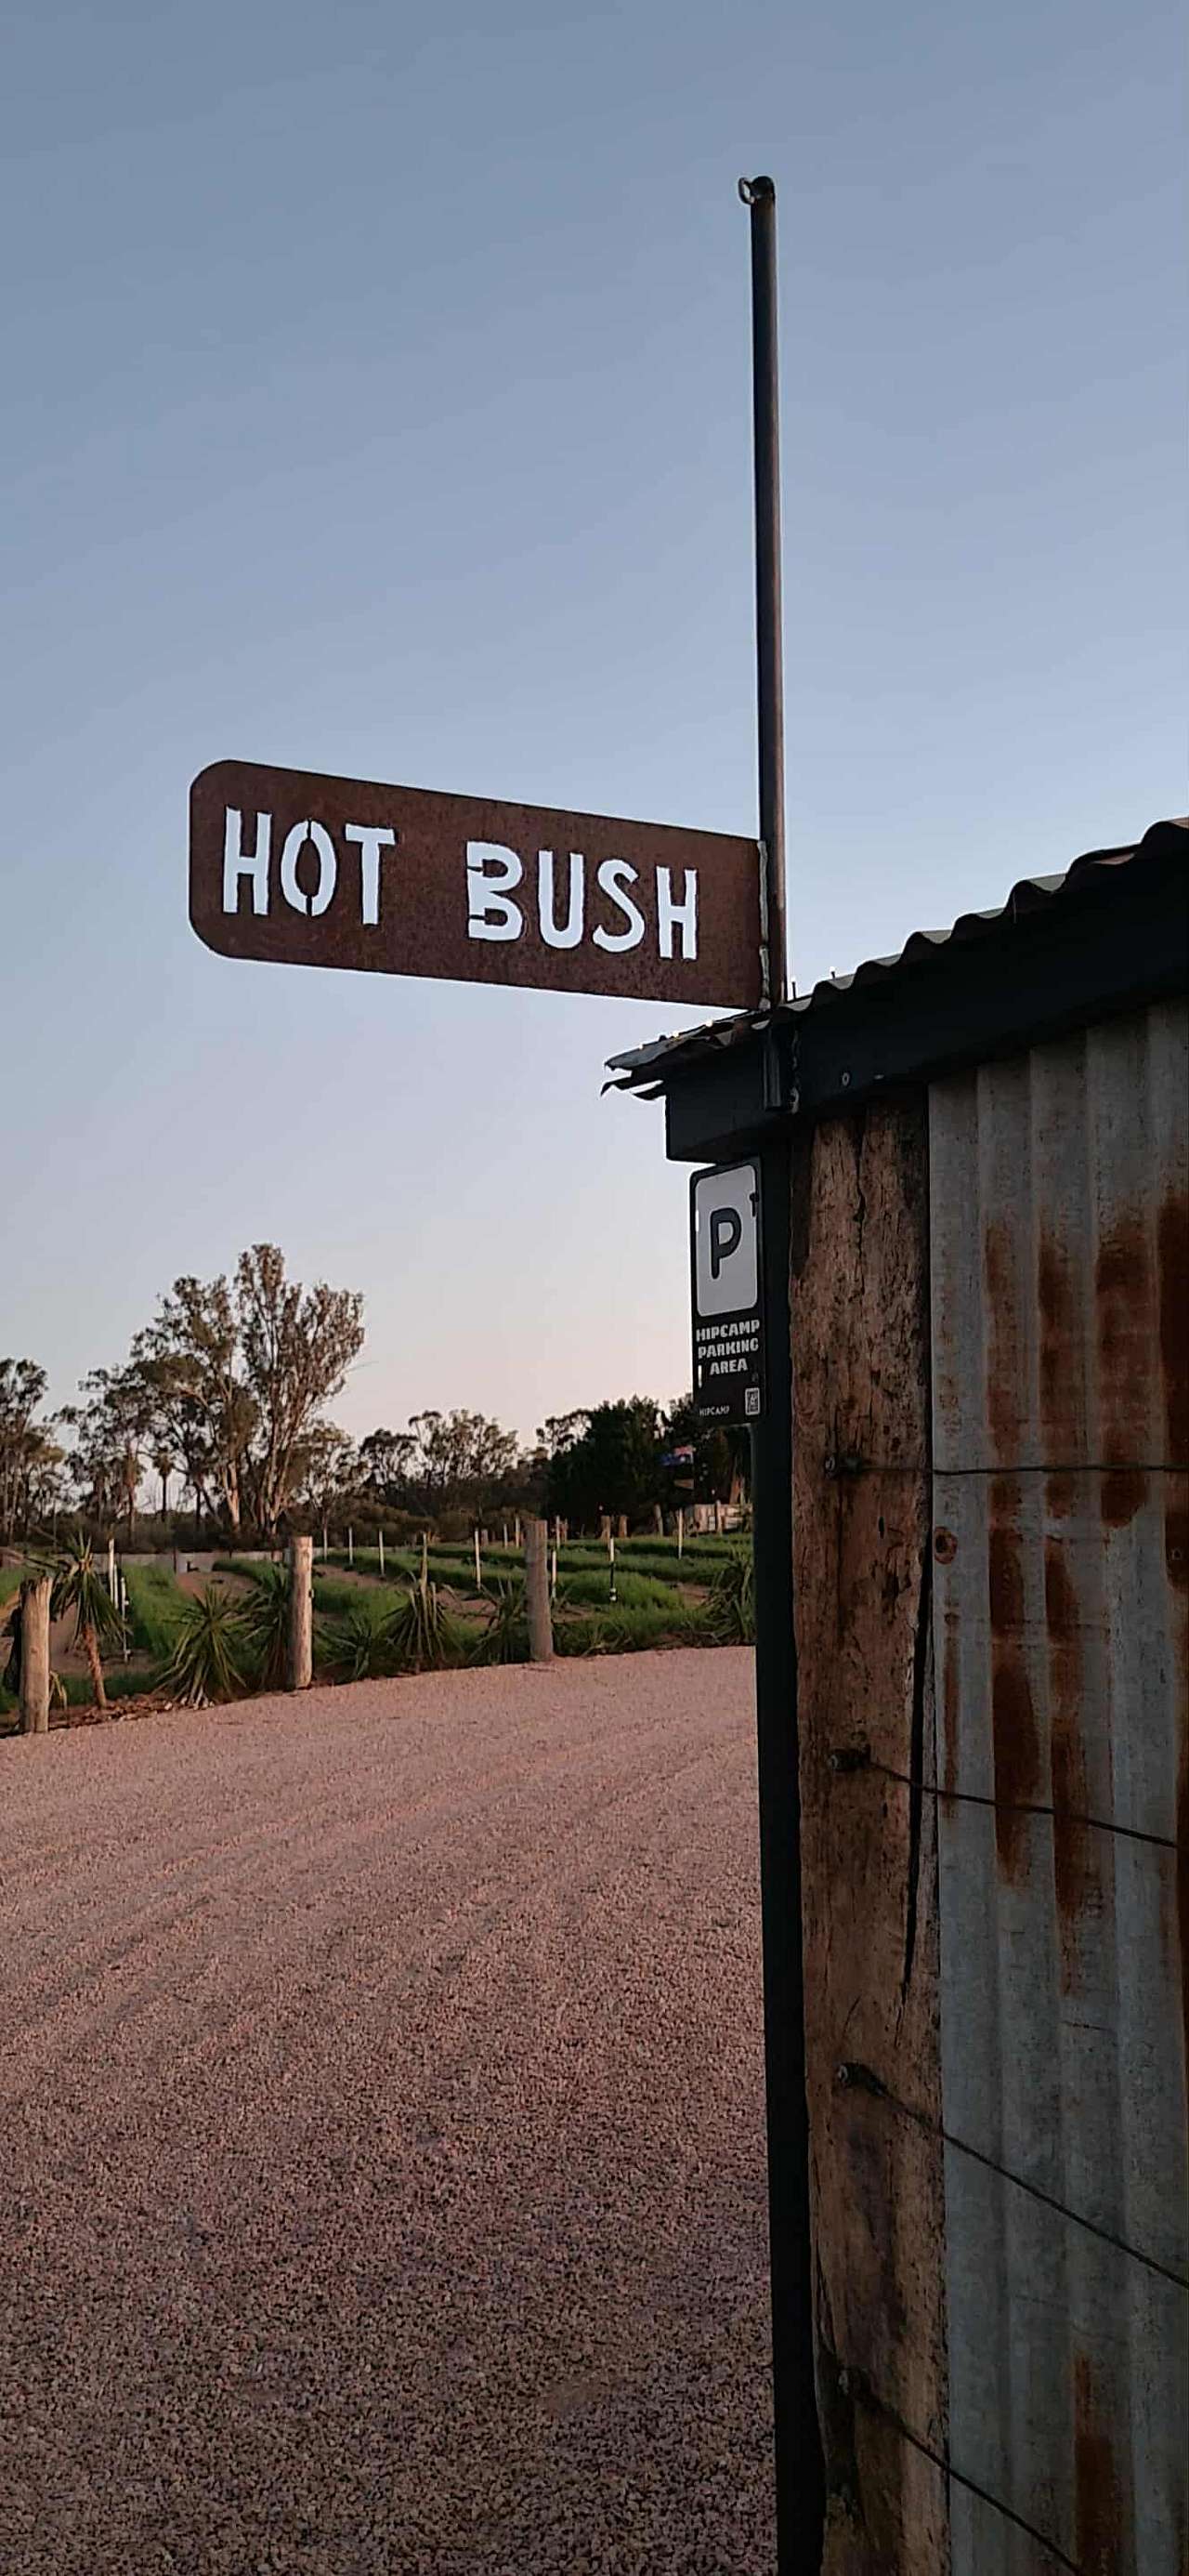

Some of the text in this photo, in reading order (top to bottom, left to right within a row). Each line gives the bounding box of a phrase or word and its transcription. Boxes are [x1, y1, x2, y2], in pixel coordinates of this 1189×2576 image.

[223, 805, 699, 960] HOT BUSH
[711, 1207, 742, 1280] P
[696, 1320, 760, 1342] HIPCAMP
[699, 1337, 759, 1359] PARKING
[710, 1358, 749, 1375] AREA
